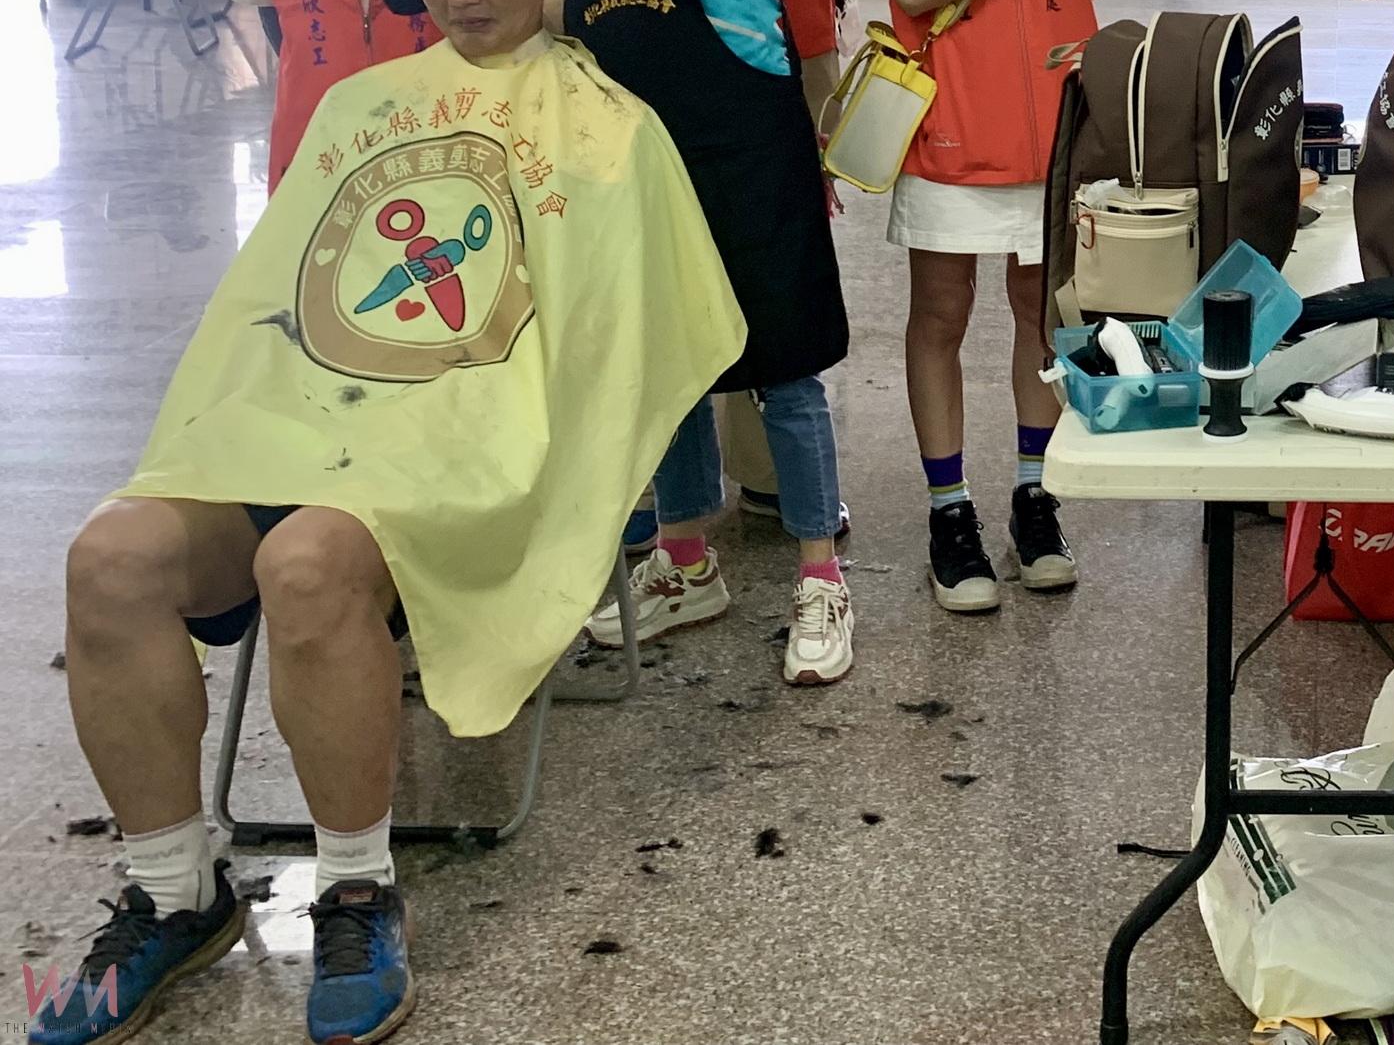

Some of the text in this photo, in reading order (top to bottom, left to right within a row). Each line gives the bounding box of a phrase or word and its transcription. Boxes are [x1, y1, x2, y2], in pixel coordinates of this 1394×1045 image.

[315, 87, 569, 219] 彰化縣義剪志工協會
[333, 144, 522, 244] 彰化縣義剪志工
